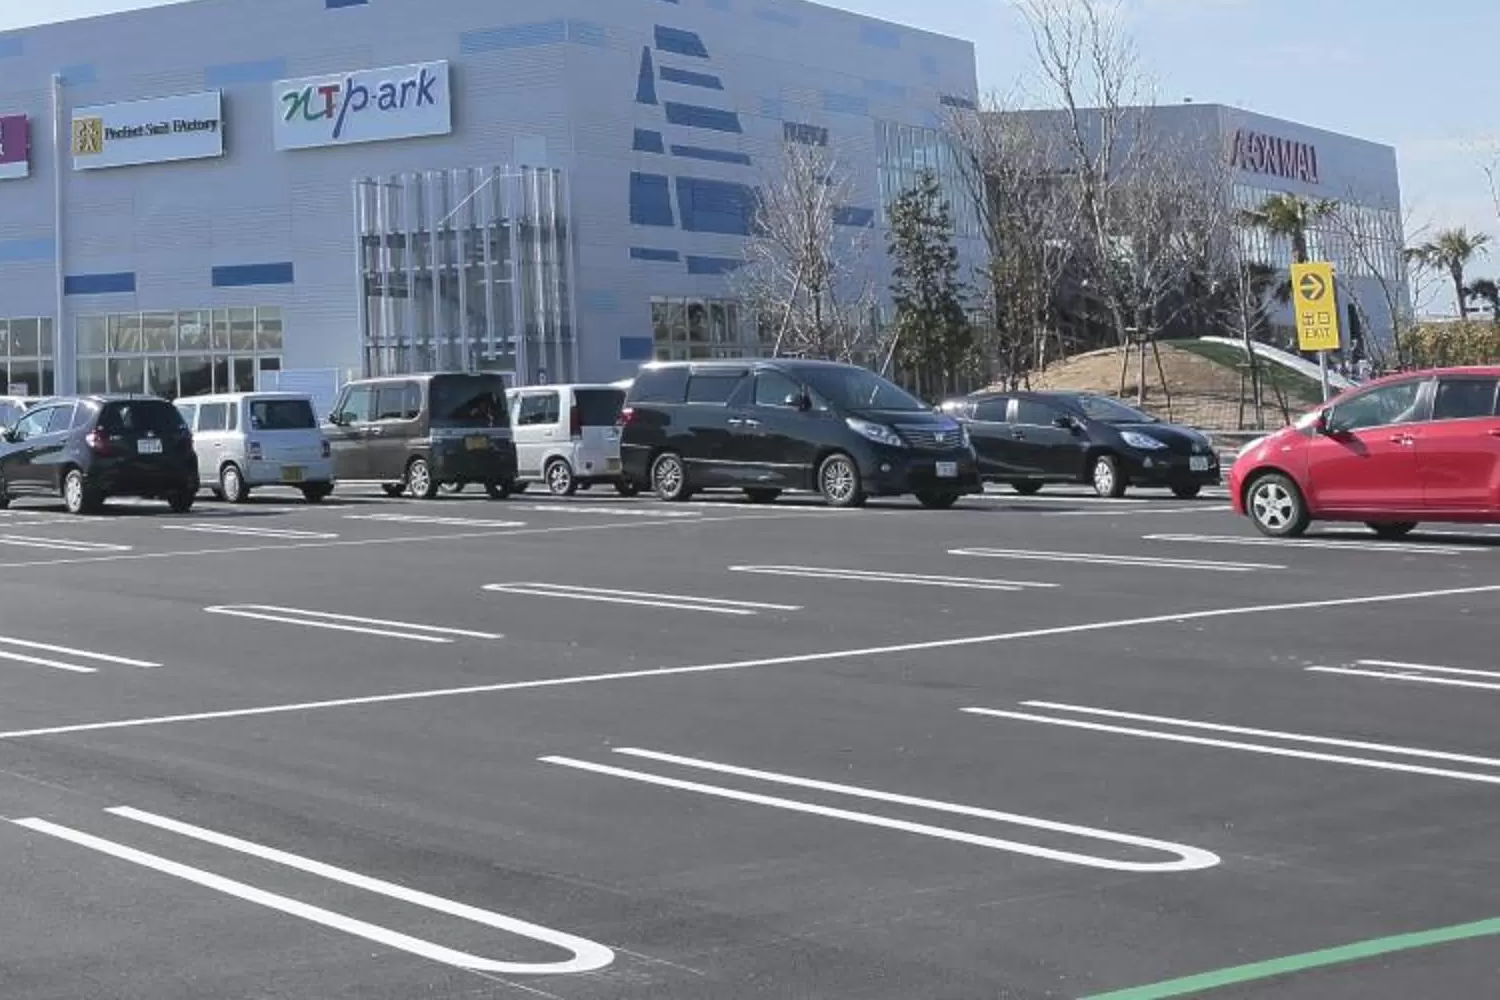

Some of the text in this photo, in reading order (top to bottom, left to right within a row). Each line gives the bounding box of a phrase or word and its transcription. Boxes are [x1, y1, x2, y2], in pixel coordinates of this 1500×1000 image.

[105, 125, 143, 141] Perfect
[145, 121, 170, 136] Suit
[1302, 311, 1331, 326] 出口
[1305, 327, 1331, 339] EXIT
